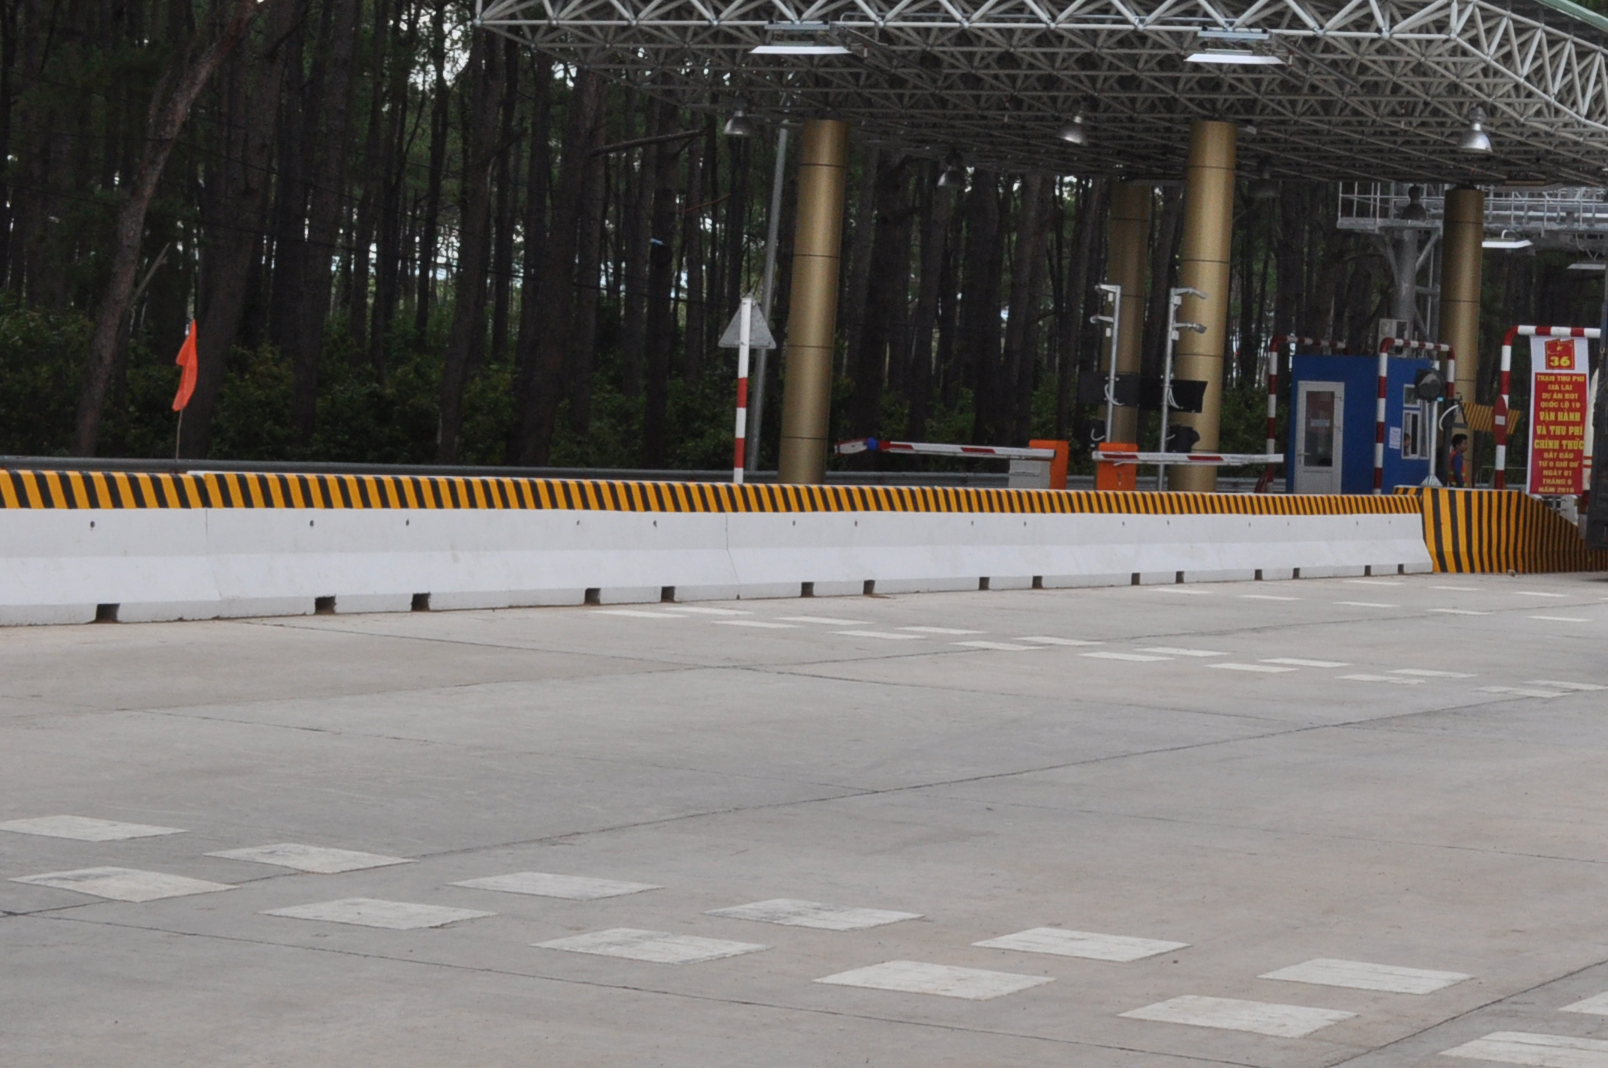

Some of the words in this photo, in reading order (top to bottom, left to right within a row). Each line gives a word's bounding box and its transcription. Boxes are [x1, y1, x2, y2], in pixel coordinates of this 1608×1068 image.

[1550, 356, 1570, 366] 36
[1539, 410, 1555, 422] VẬN
[1558, 410, 1580, 421] HÀNH
[1536, 423, 1546, 435] VÀ
[1549, 425, 1566, 435] THU
[1569, 424, 1582, 435] PHÍ
[1534, 437, 1559, 449] CHÍNH
[1562, 437, 1584, 450] THỨC
